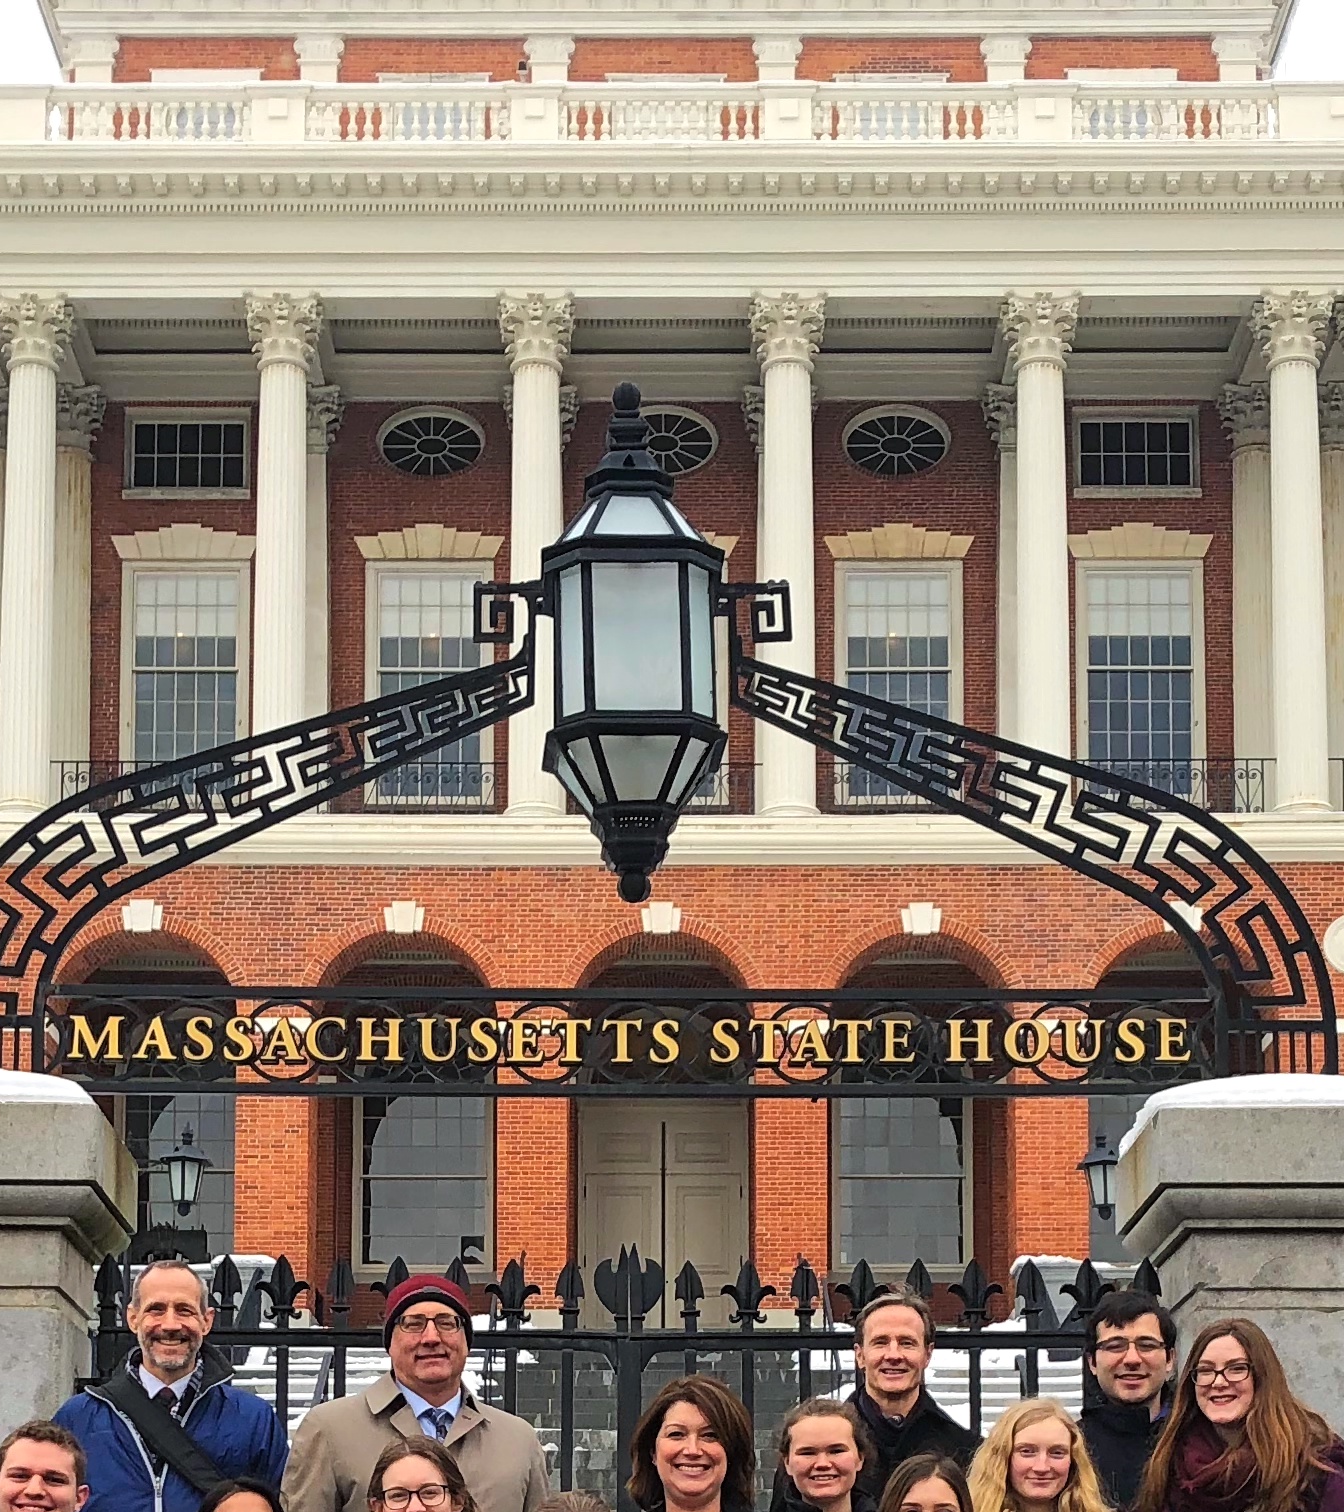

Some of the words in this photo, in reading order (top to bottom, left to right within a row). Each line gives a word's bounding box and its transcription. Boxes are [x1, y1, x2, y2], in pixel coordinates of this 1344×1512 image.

[66, 1015, 681, 1066] MASSACHUSETTS
[709, 1018, 916, 1066] STATE
[945, 1017, 1192, 1066] HOUSE
